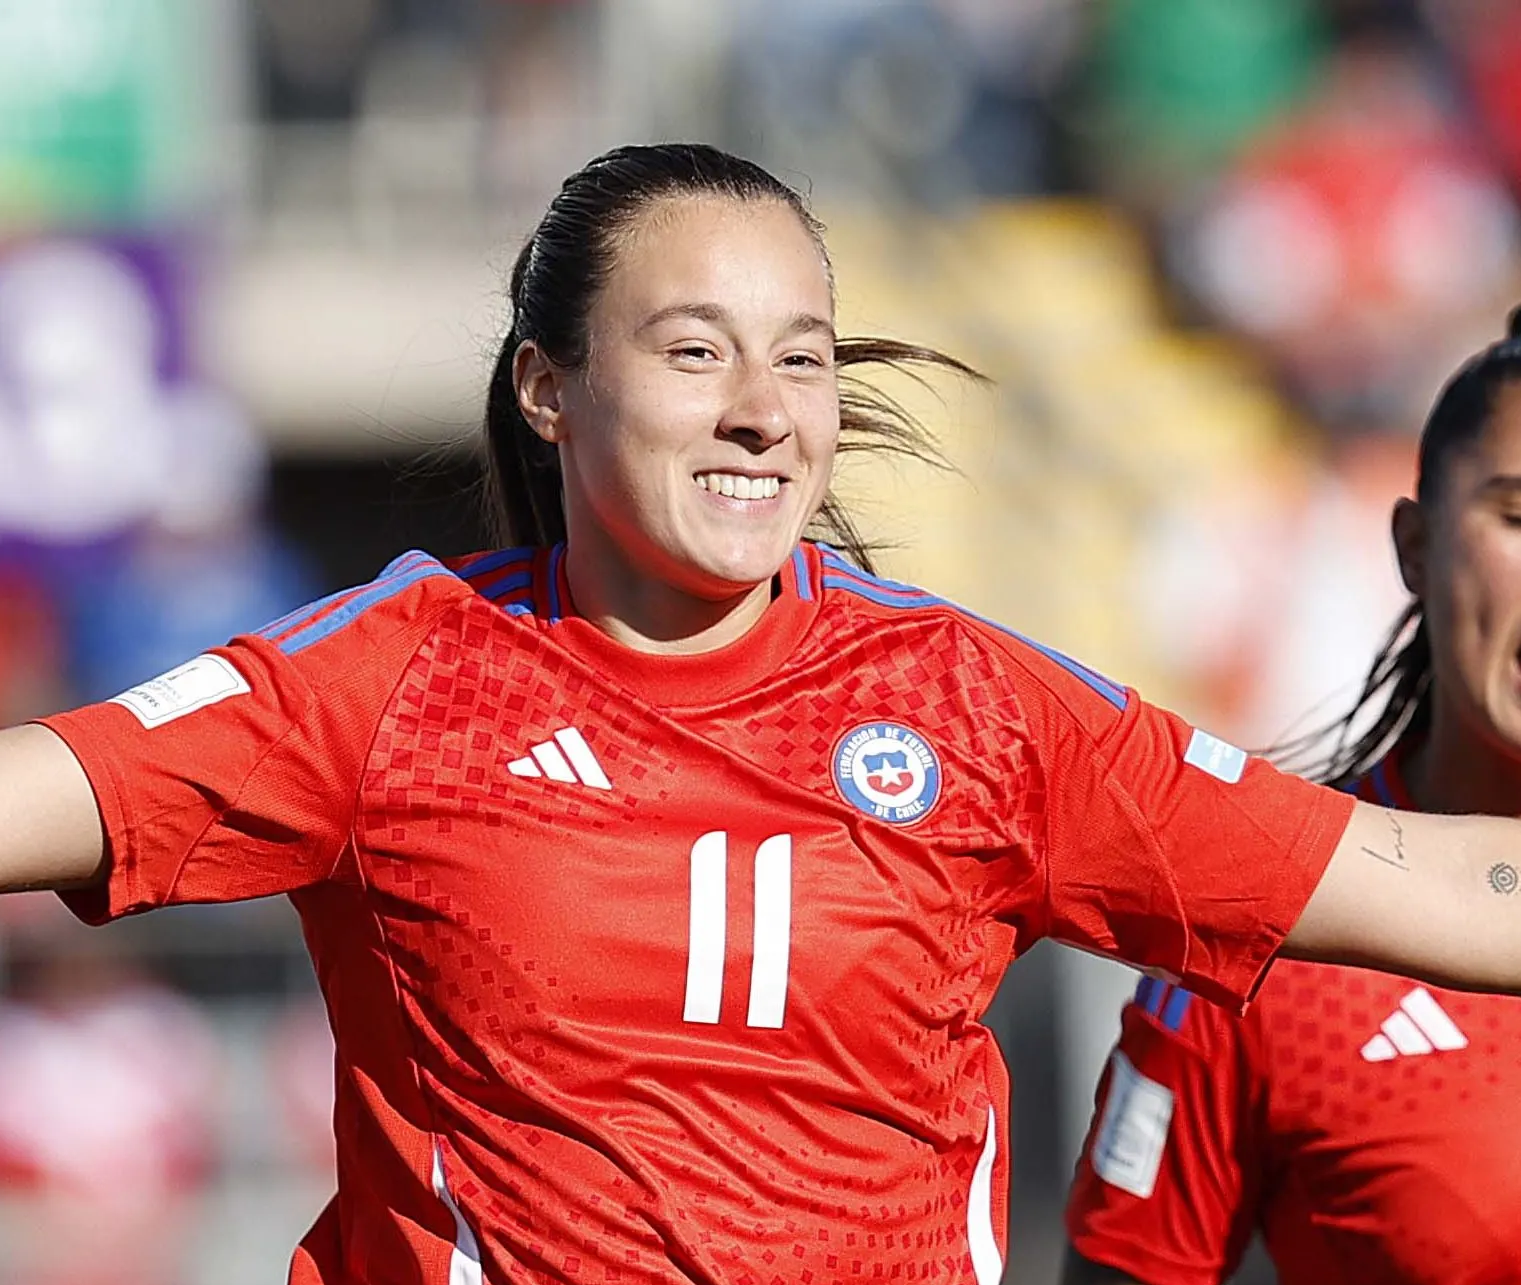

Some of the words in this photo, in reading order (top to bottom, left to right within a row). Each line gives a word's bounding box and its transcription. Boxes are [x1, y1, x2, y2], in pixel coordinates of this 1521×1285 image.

[884, 727, 899, 739] DE
[904, 733, 934, 770] FUTBOL
[875, 805, 890, 818] DE
[895, 800, 924, 818] CHILE
[683, 830, 792, 1029] 11
